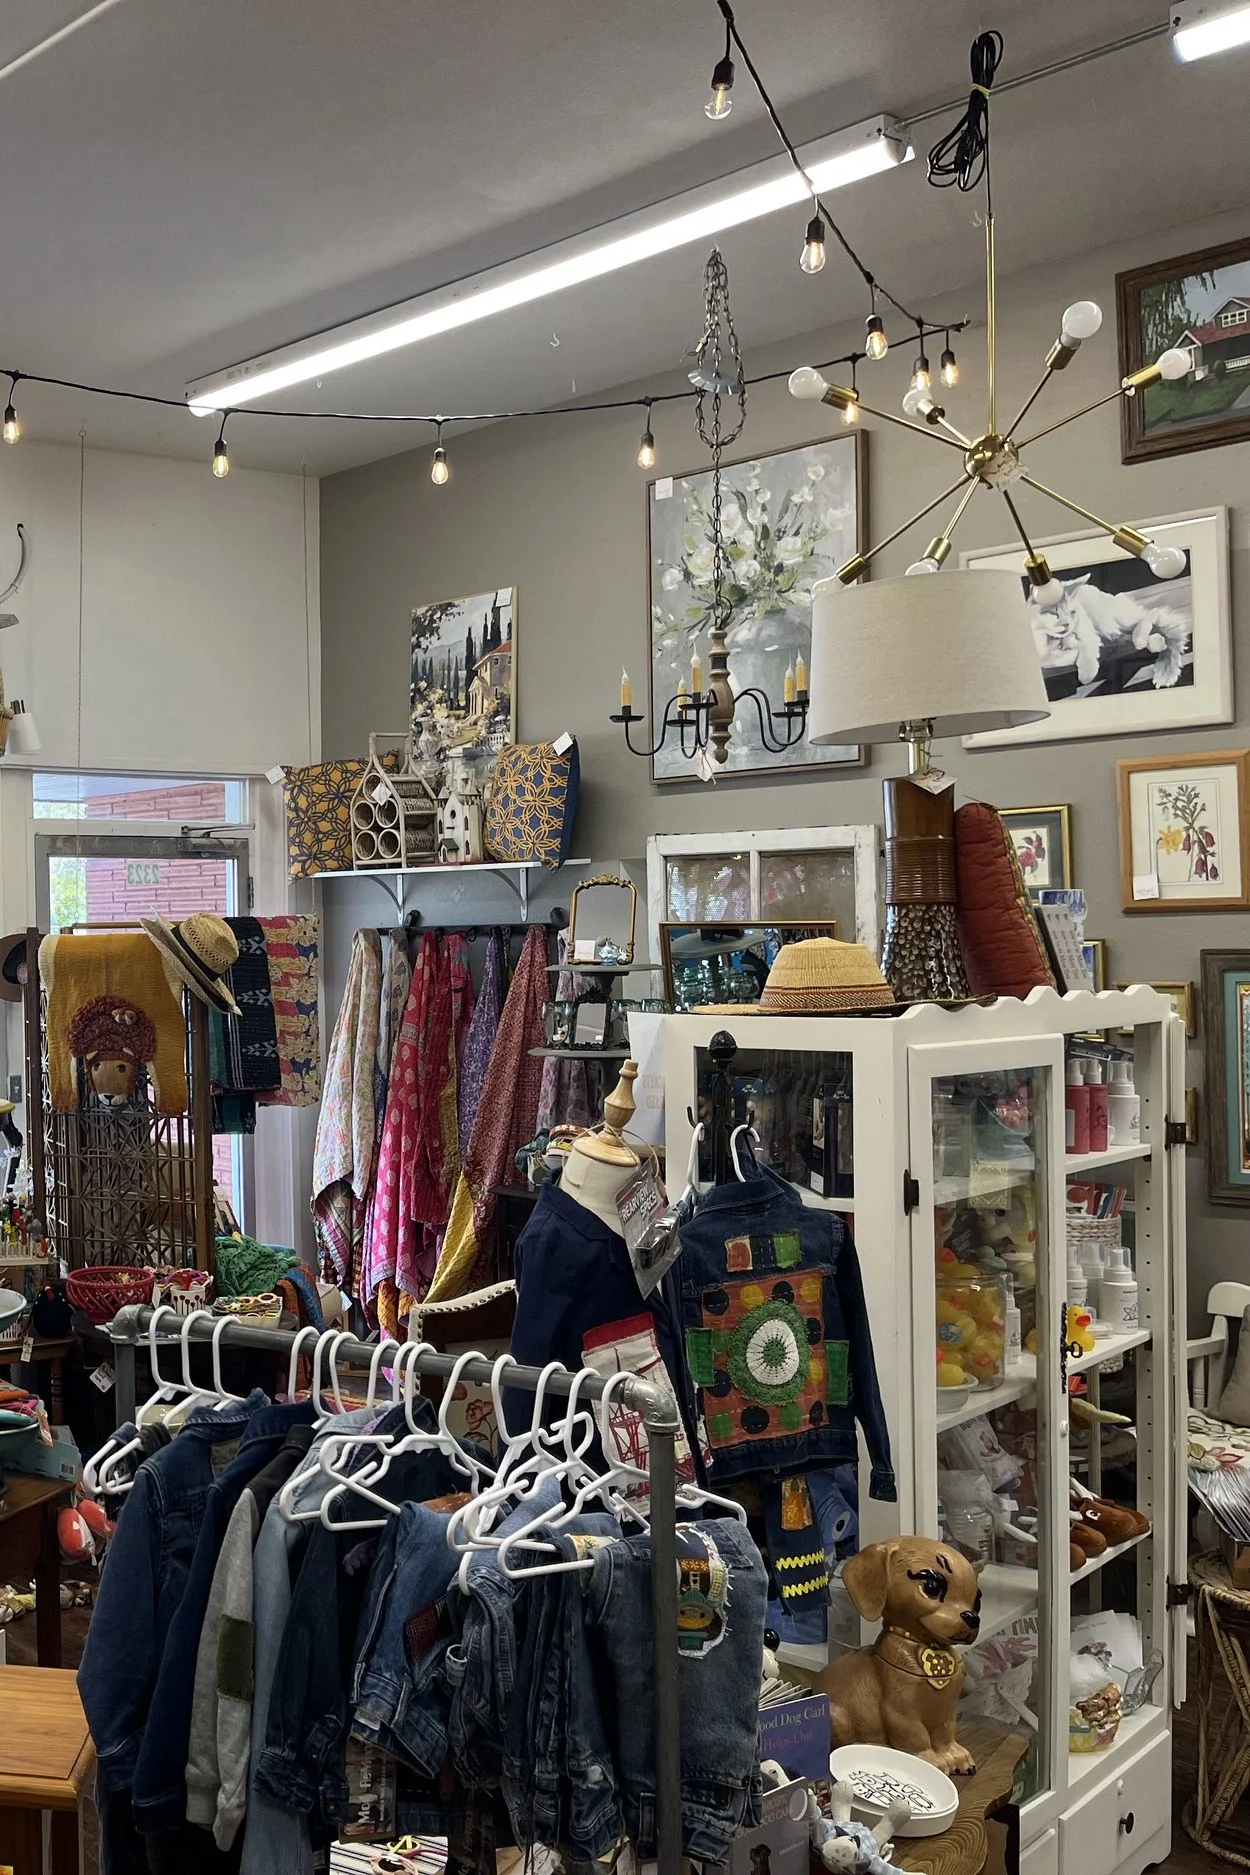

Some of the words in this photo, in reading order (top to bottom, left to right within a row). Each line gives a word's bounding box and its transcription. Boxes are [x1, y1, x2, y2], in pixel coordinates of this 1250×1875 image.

[621, 1180, 650, 1224] REARVIEW
[639, 1187, 658, 1221] SPECS
[757, 1717, 778, 1731] ood
[781, 1712, 802, 1727] Dog
[804, 1704, 825, 1721] Carl
[763, 1735, 791, 1751] Helps
[793, 1732, 813, 1744] Out
